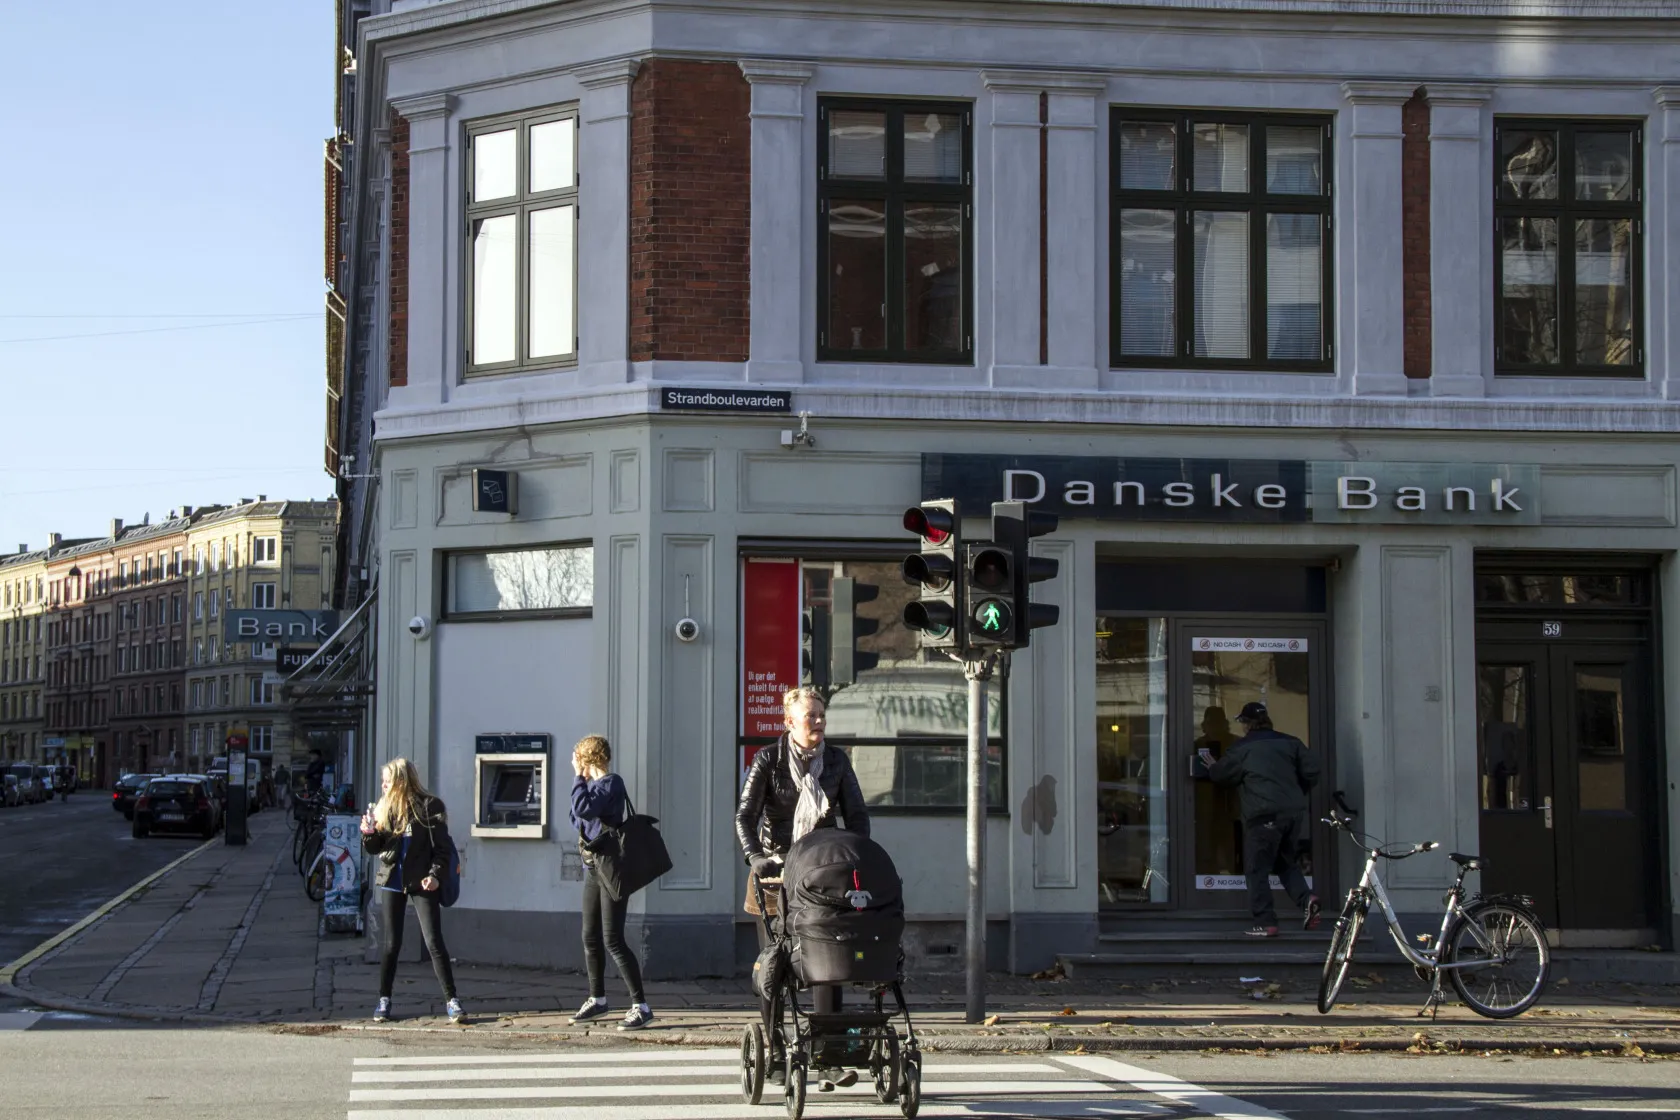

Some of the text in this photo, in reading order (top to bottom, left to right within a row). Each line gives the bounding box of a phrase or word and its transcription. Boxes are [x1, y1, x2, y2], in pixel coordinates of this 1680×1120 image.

[667, 391, 785, 407] Strandboulevarden
[1003, 469, 1523, 512] Danske Bank
[238, 616, 329, 637] Bank
[1544, 623, 1560, 636] 59
[766, 672, 776, 681] det
[748, 683, 767, 692] enkelt
[768, 683, 777, 692] for
[748, 694, 754, 703] at
[756, 722, 772, 732] Fjern
